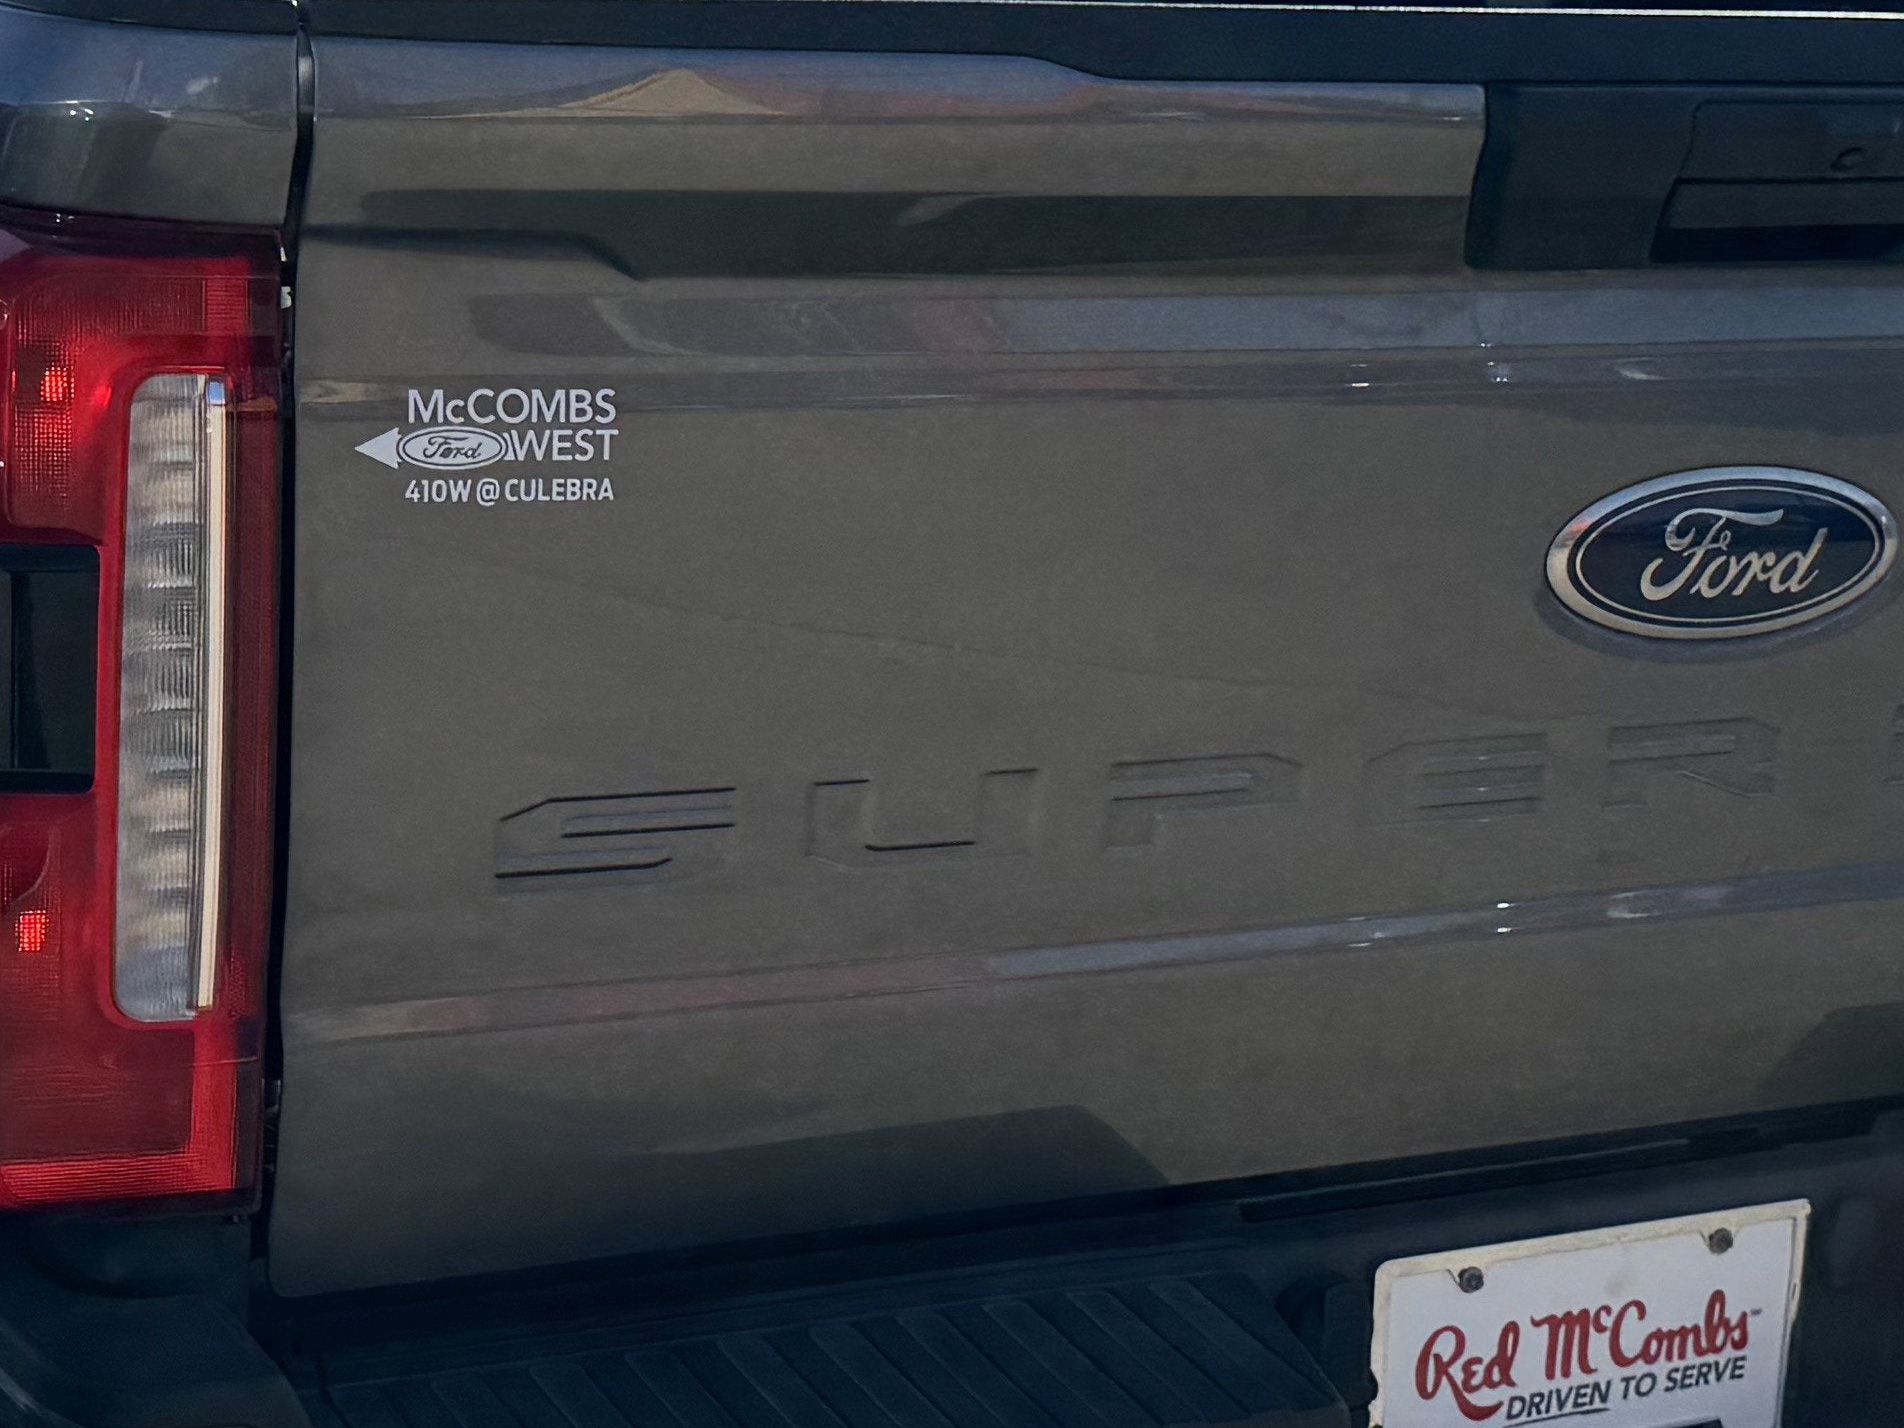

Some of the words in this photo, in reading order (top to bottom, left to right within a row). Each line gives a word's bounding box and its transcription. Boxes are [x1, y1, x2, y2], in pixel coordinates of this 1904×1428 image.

[407, 387, 617, 424] McCOMBS
[421, 435, 483, 460] Ford
[507, 428, 619, 461] WEST
[1639, 507, 1829, 602] Ford
[493, 715, 1778, 899] SUPER
[1415, 1320, 1520, 1422] Red
[1529, 1289, 1749, 1381] McCombs
[1504, 1379, 1612, 1421] DRIVEN
[1620, 1373, 1658, 1400] TO
[1663, 1355, 1747, 1393] SERVE
